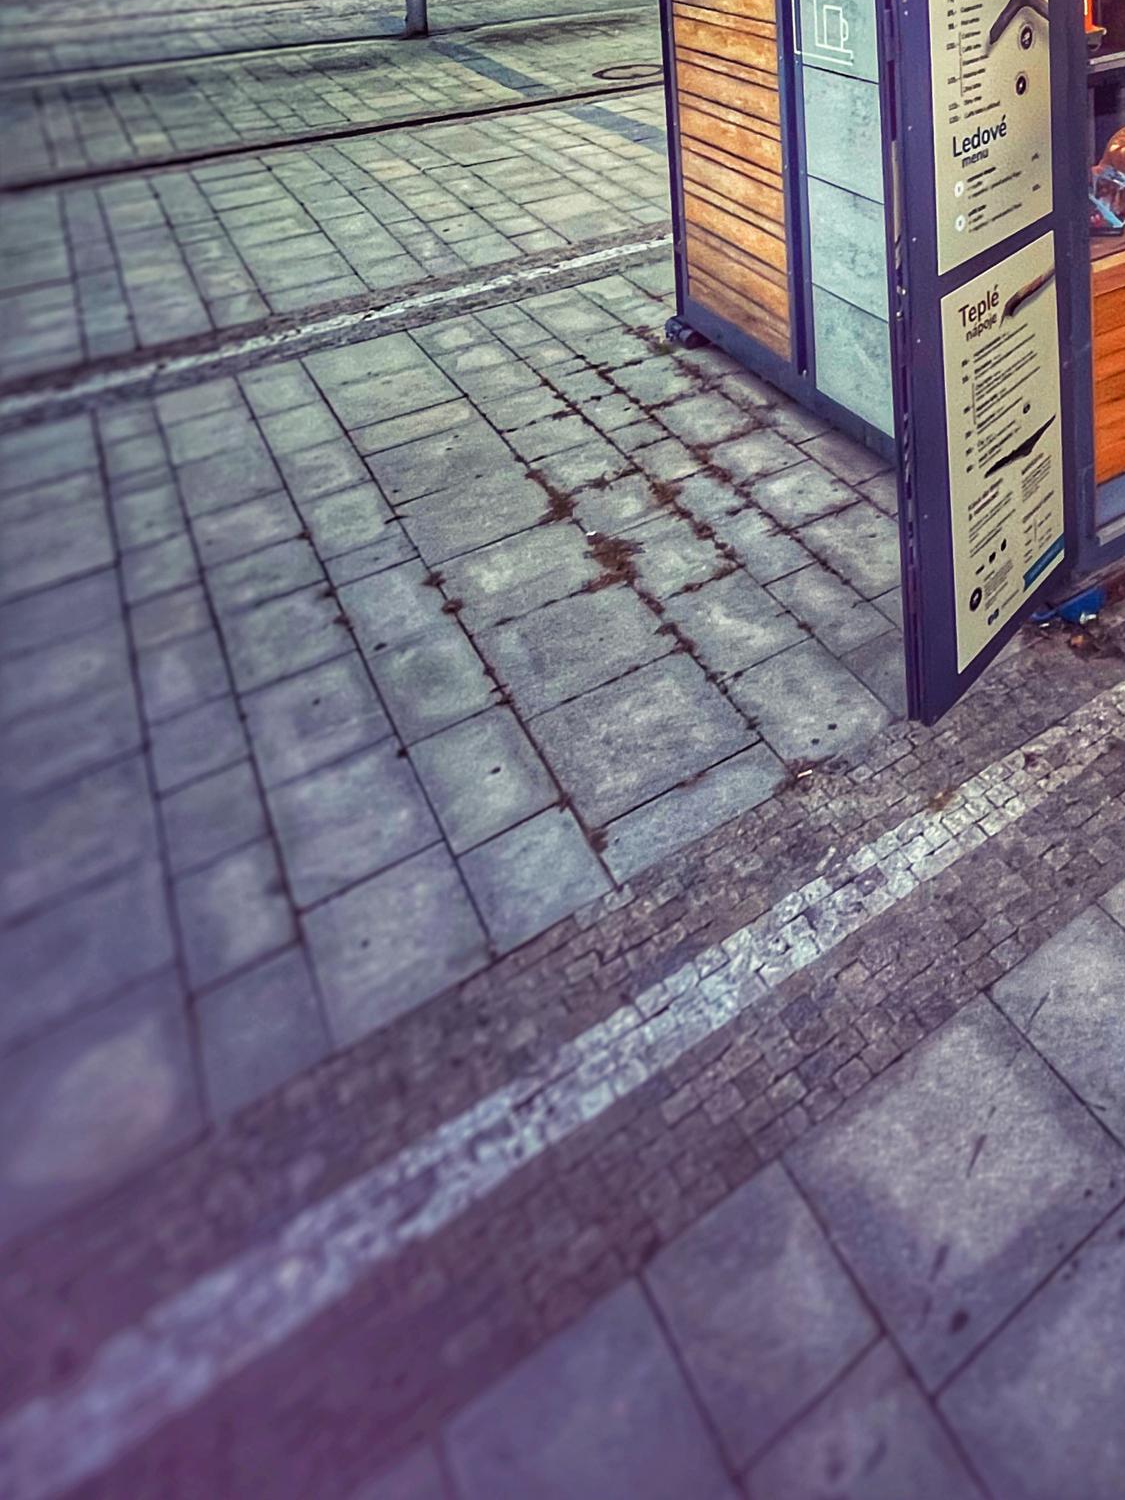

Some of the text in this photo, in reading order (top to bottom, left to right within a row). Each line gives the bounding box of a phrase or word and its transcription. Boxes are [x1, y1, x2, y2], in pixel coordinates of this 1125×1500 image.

[952, 114, 1008, 158] Ledové
[962, 148, 989, 168] menu
[958, 284, 1000, 328] Teplé
[966, 312, 998, 342] nápoje
